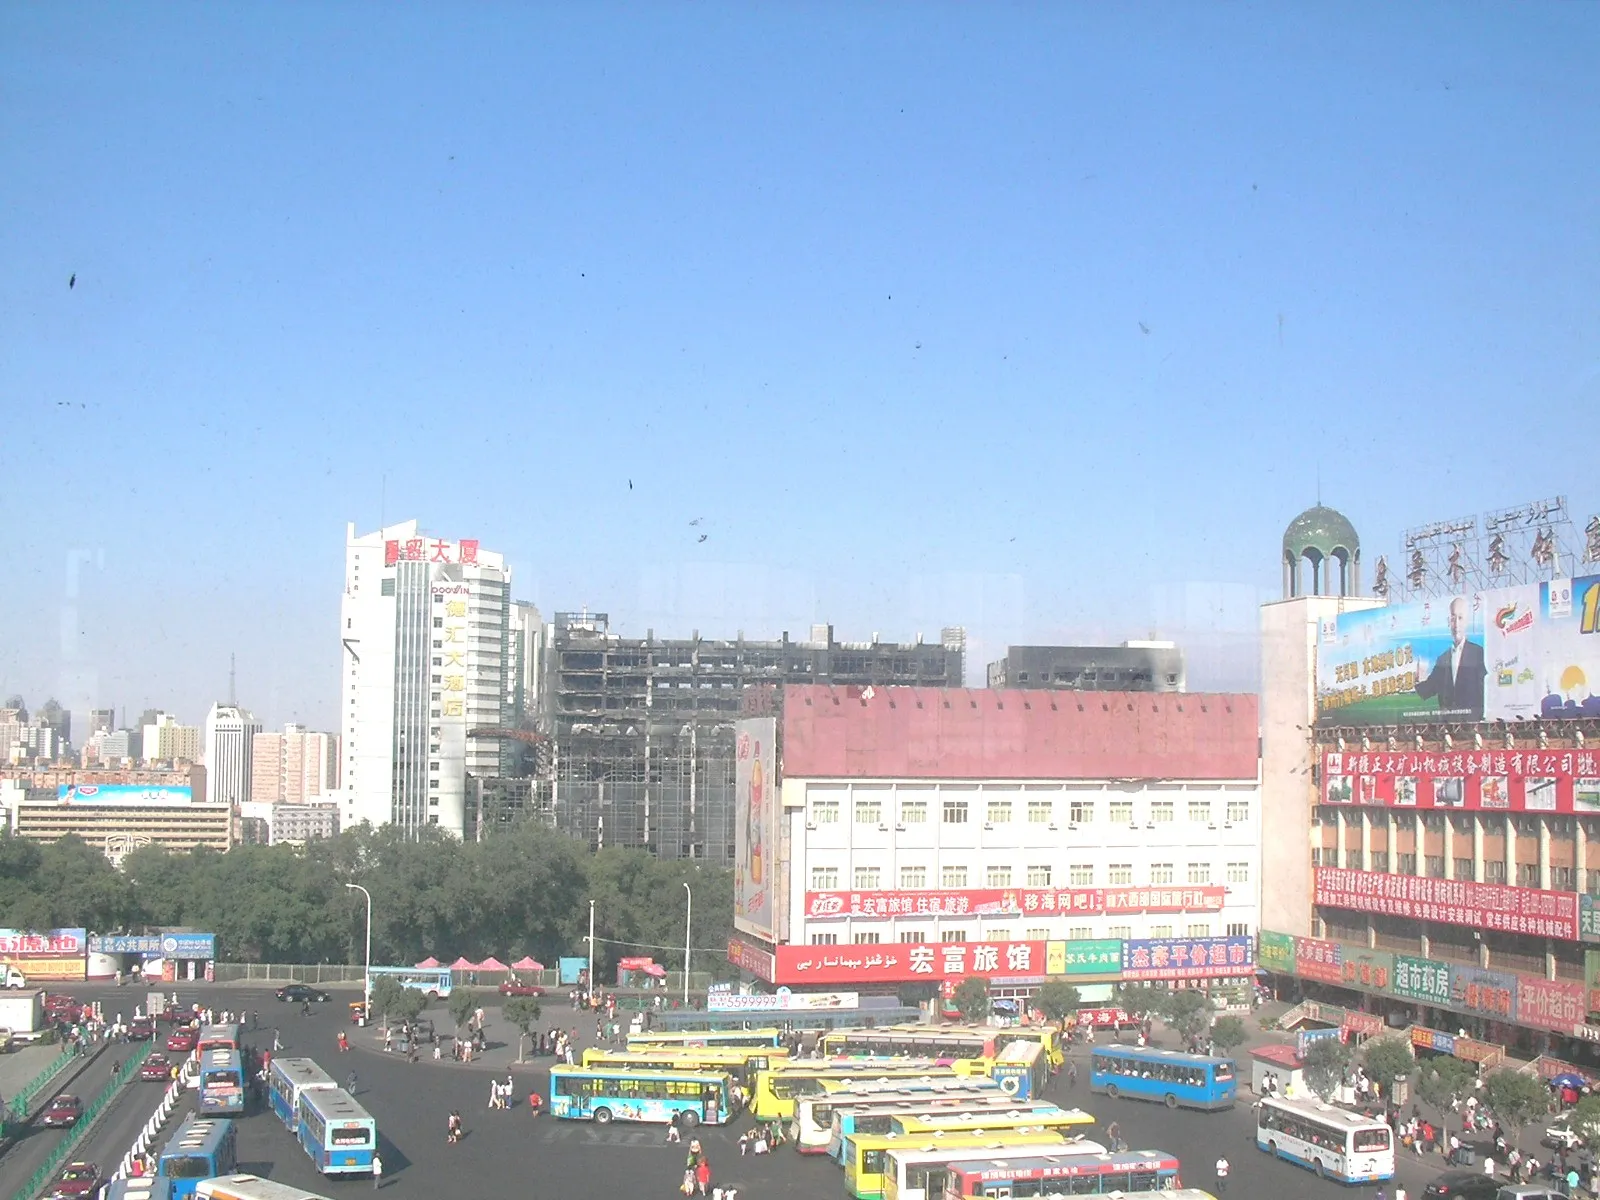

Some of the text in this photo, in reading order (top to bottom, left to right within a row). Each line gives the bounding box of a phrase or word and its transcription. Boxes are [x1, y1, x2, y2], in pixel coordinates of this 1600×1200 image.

[443, 600, 466, 718] 德汇大酒店
[1347, 752, 1572, 776] 新疆正大矿山机械设备制造有限公司
[863, 897, 913, 913] 宏富旅馆
[917, 897, 941, 912] 住宿
[944, 896, 969, 913] 旅游
[1024, 893, 1087, 911] 移海网吧
[1414, 903, 1482, 926] 免费设计安装调试
[1486, 911, 1572, 938] 常年供应各种机械配件
[909, 943, 1032, 974] 宏富旅馆
[1397, 961, 1449, 997] 超市药房
[726, 996, 776, 1008] 5599999
[1523, 985, 1577, 1021] 平价超市
